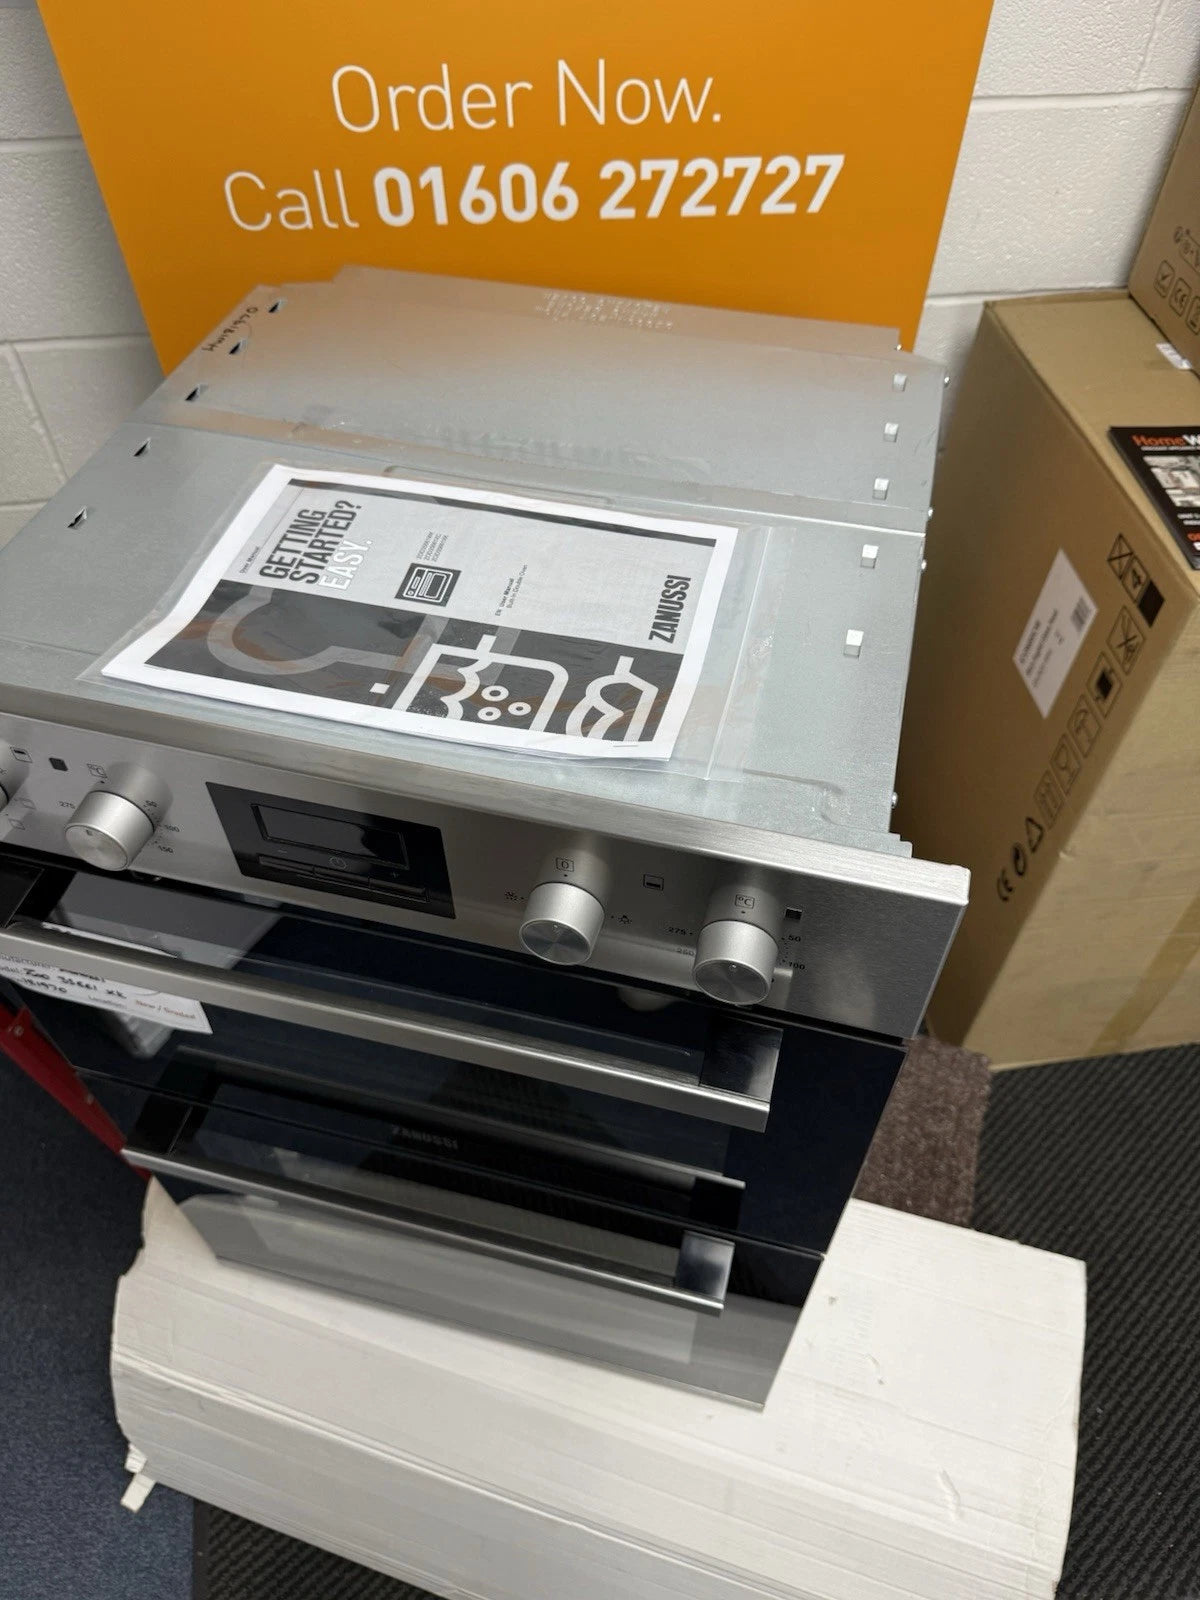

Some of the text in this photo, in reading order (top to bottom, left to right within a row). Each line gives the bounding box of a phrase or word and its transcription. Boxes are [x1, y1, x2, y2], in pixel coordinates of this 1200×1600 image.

[332, 57, 722, 134] Order Now.
[223, 153, 845, 232] Call 01606 272727
[259, 508, 327, 579] GETTING
[289, 500, 362, 584] STARTED?
[317, 539, 372, 590] EASY.
[648, 574, 691, 644] ZANUSSI
[668, 927, 801, 942] 275 50
[788, 961, 806, 970] 100
